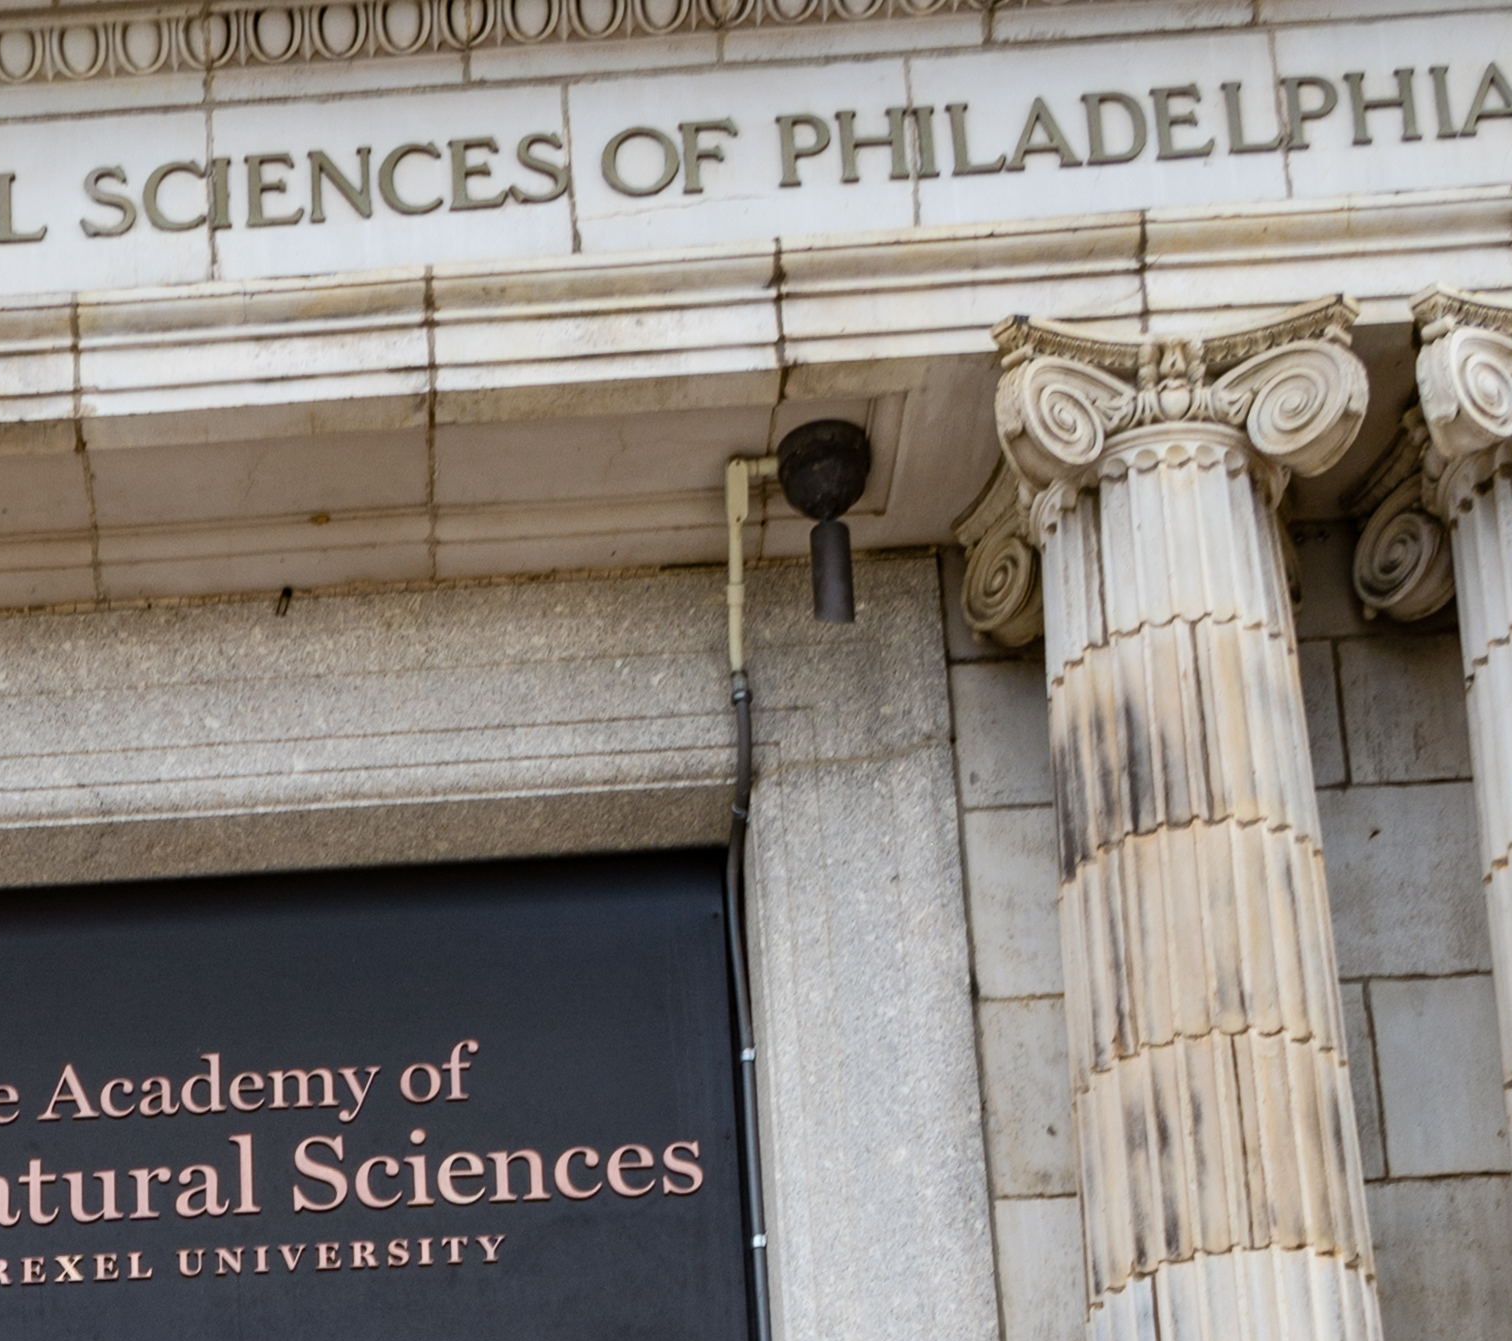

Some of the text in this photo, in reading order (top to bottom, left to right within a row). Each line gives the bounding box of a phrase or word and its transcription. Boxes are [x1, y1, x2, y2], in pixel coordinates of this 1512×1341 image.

[80, 131, 571, 238] SCIENCES
[600, 117, 737, 197] OF
[38, 1051, 380, 1123] Academy
[398, 1039, 478, 1102] of
[293, 1127, 704, 1212] Sciences
[178, 1234, 508, 1280] UNIVERSITY
